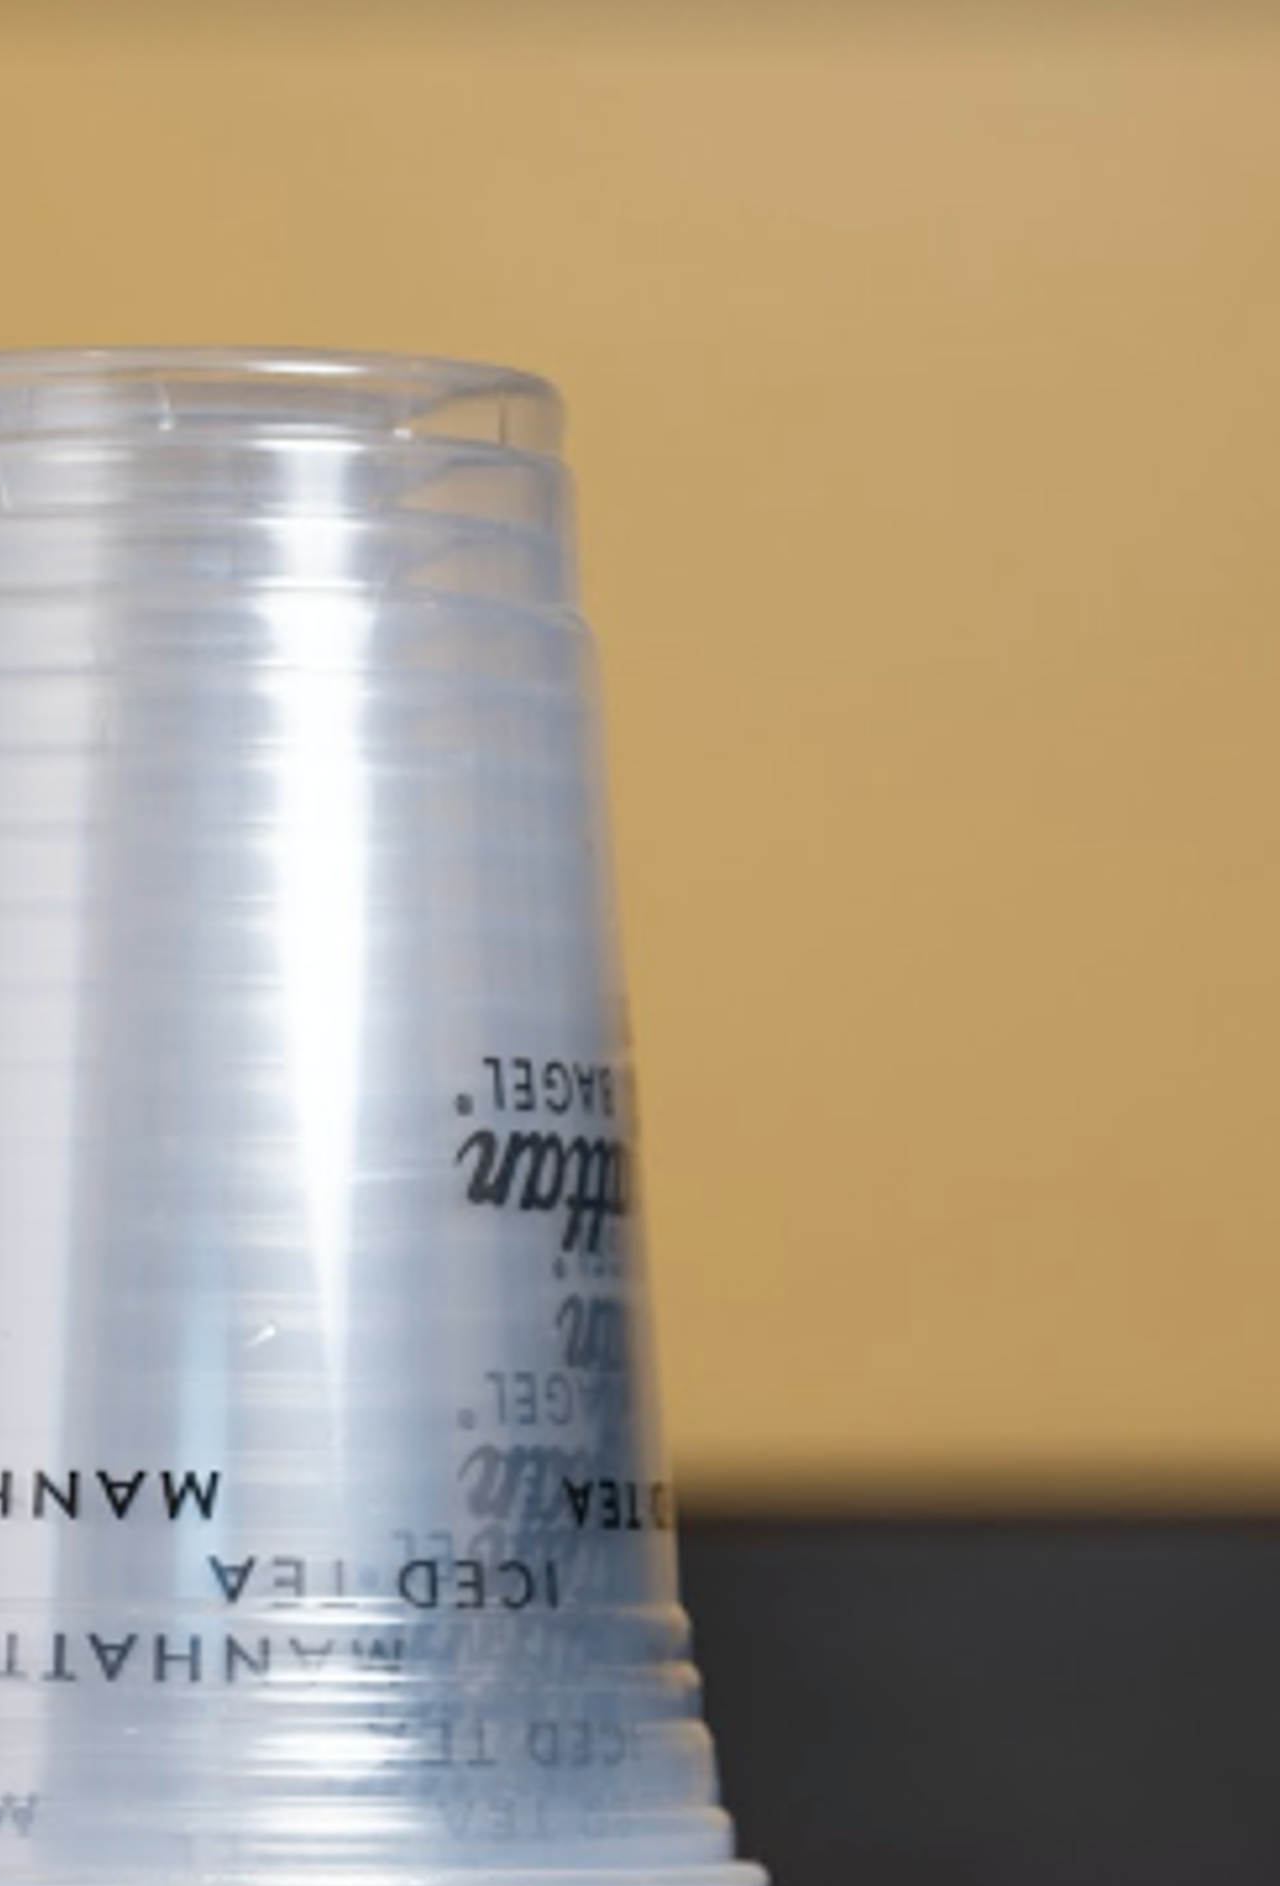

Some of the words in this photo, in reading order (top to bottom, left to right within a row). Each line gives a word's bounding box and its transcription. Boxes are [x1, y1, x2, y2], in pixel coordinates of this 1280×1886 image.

[562, 1476, 644, 1531] TEA
[207, 1555, 359, 1608] TEA
[398, 1559, 560, 1610] ICED
